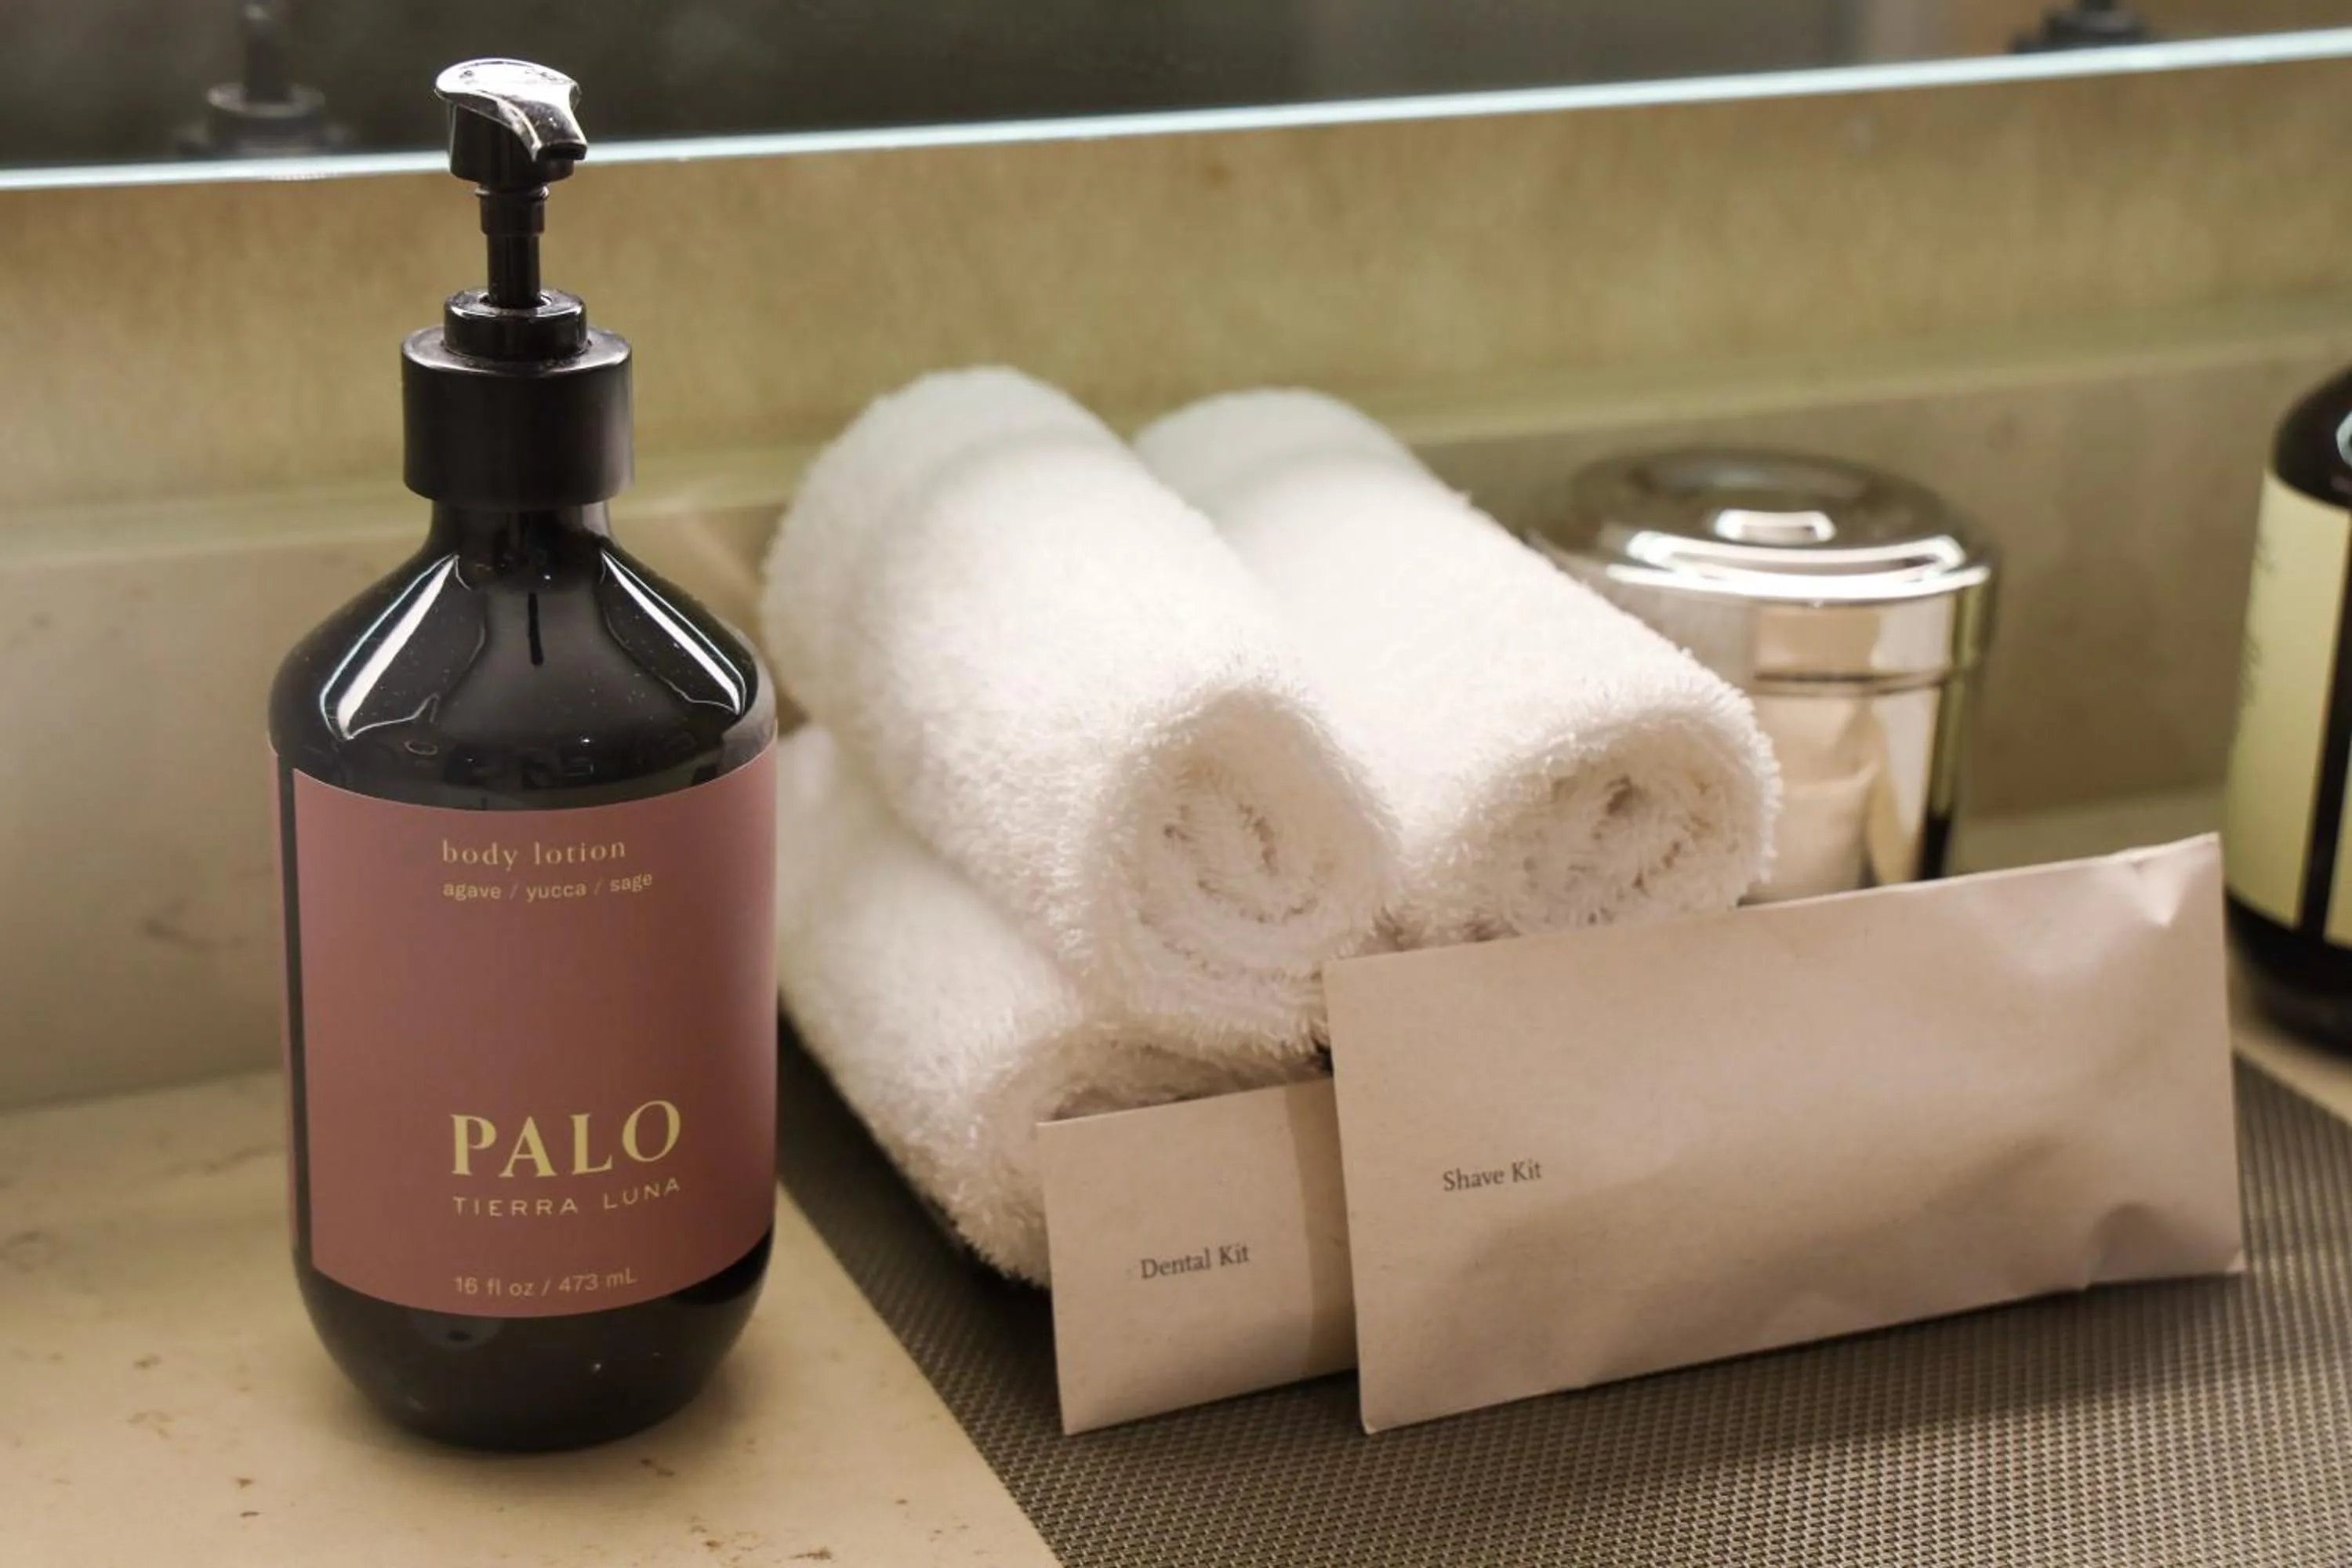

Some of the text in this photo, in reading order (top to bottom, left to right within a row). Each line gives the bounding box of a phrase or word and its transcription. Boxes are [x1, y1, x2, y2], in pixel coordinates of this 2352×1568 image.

[442, 839, 626, 872] body lotion
[443, 883, 502, 901] agave
[526, 883, 586, 902] yucca
[609, 873, 652, 892] sage
[449, 1100, 681, 1178] PALO
[1443, 1159, 1543, 1192] Shave Kit
[452, 1178, 680, 1217] TIERRA LUNA
[1141, 1243, 1250, 1280] Dental Kit
[455, 1276, 478, 1295] 16
[487, 1278, 501, 1296] fl
[509, 1282, 533, 1297] oz
[558, 1273, 599, 1293] 473
[606, 1266, 638, 1287] mL
